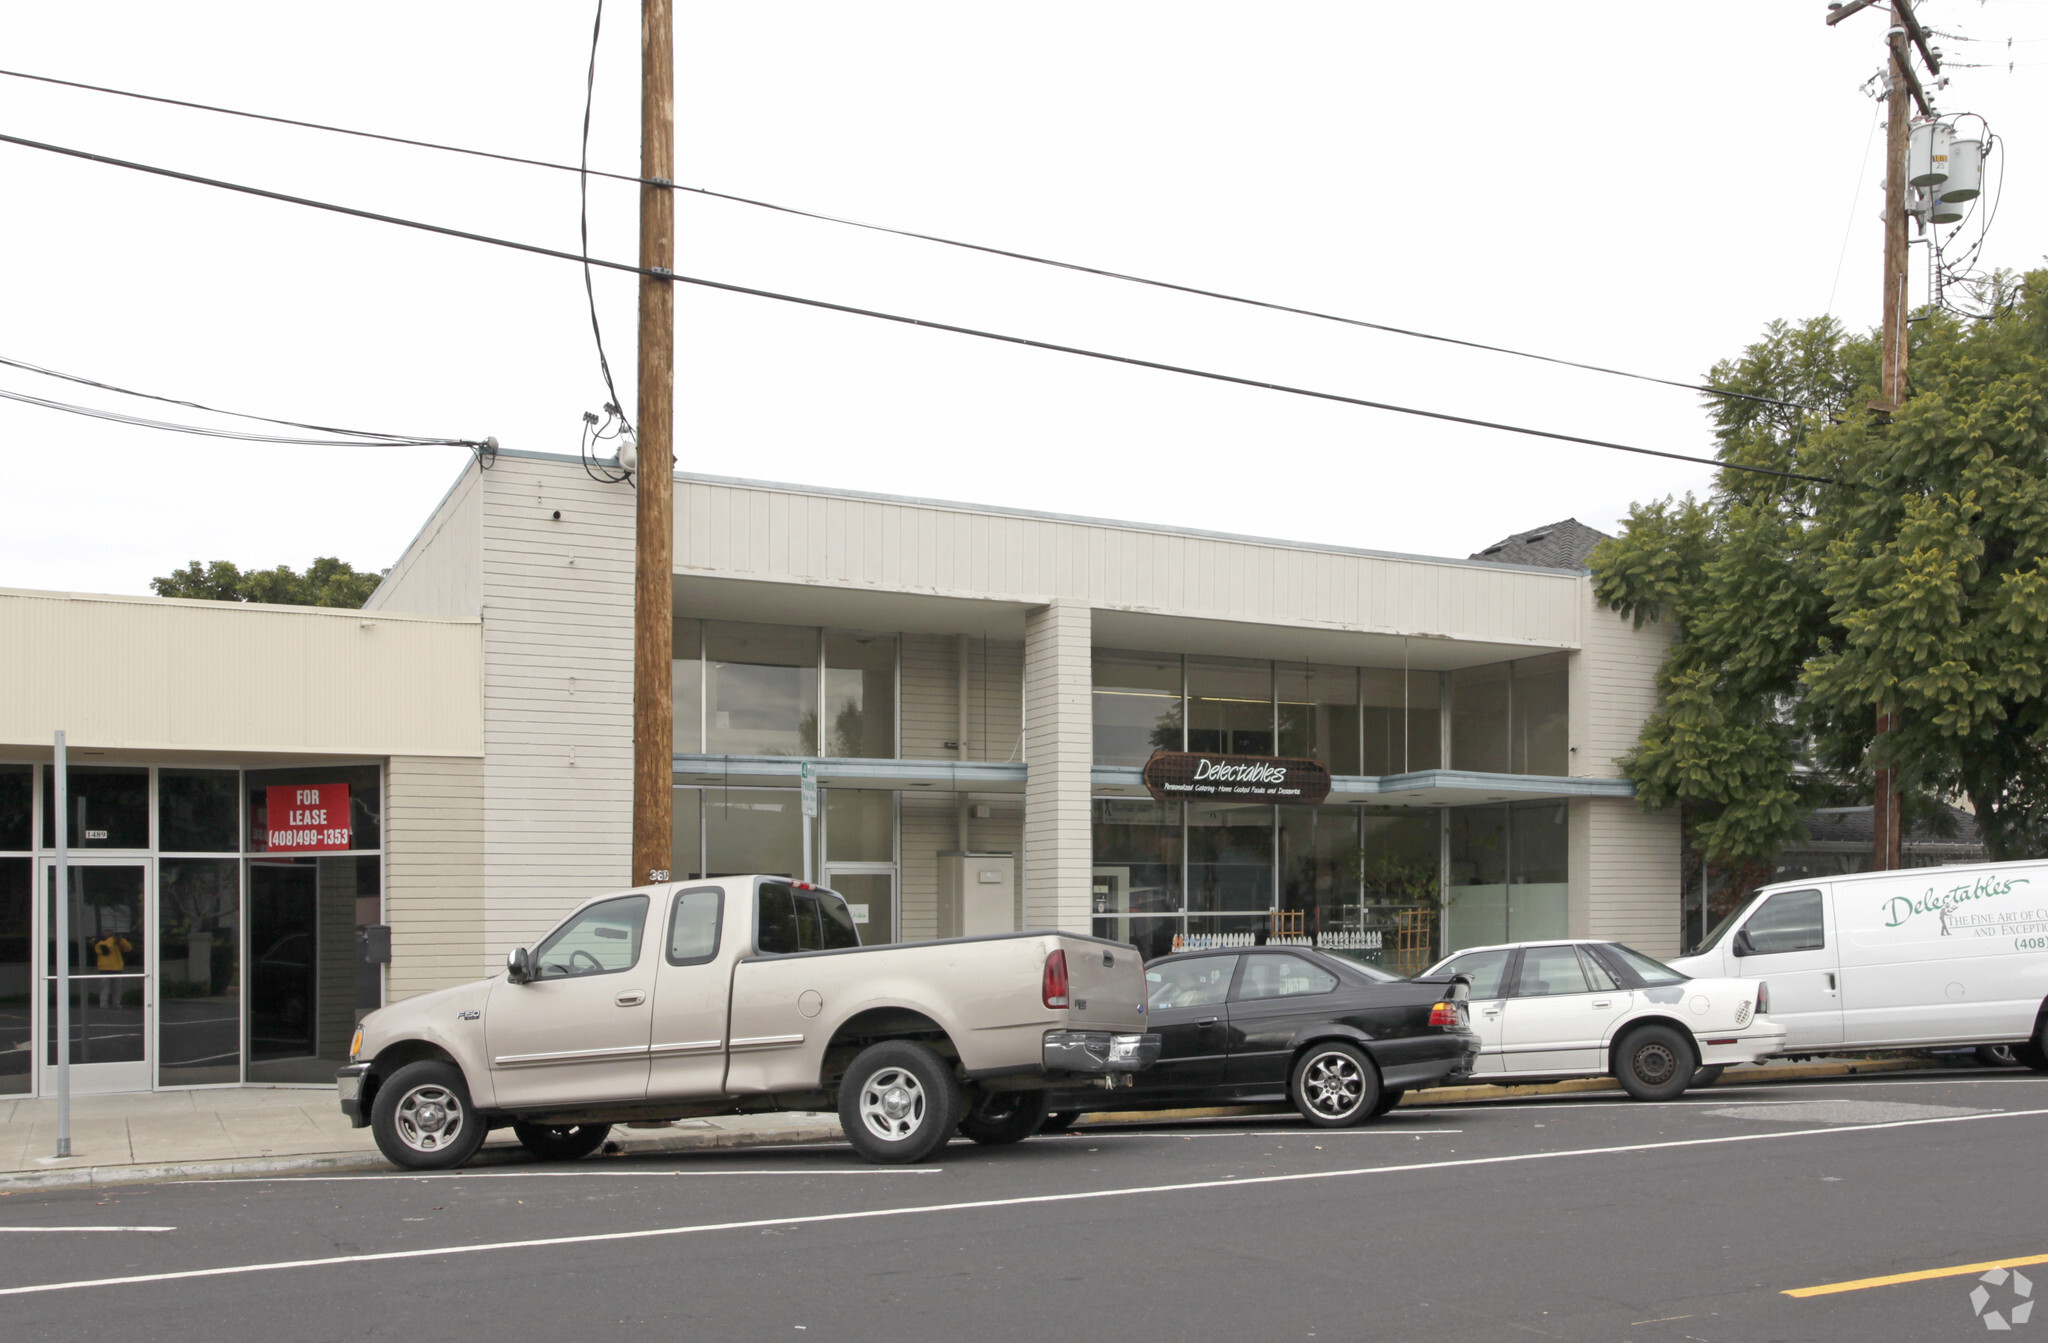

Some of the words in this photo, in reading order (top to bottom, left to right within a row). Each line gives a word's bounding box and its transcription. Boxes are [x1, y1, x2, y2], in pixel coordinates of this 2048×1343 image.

[1194, 759, 1287, 783] Delectables
[296, 790, 320, 805] FOR
[289, 809, 327, 826] LEASE
[269, 829, 348, 847] (408)499-1353
[1882, 875, 2030, 928] Delectables
[1947, 916, 1968, 926] THE
[1970, 914, 1994, 924] FINE
[1998, 912, 2018, 922] ART
[2020, 910, 2034, 920] OF
[1974, 928, 1996, 938] AND
